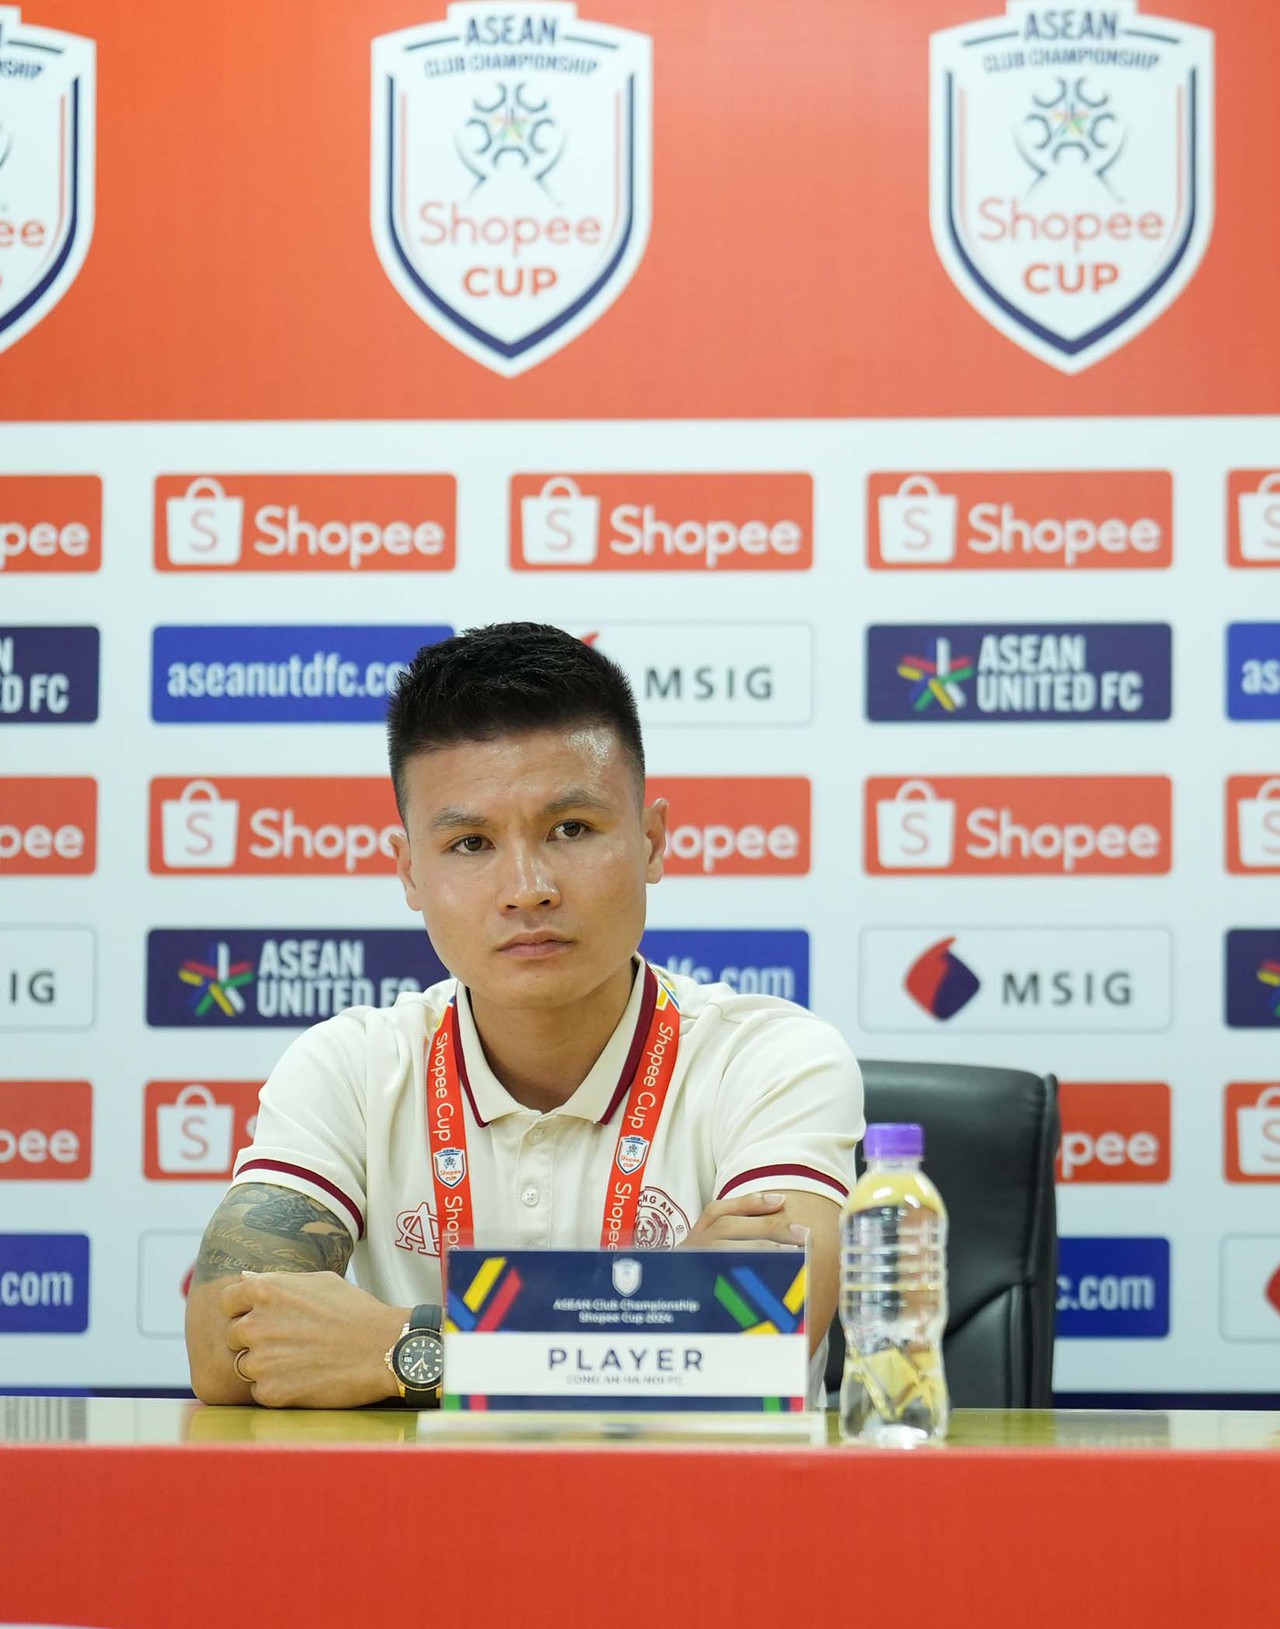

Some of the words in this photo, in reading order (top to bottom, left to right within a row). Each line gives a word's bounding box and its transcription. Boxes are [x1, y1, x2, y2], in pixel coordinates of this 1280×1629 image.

[465, 16, 559, 46] ASEAN
[1023, 10, 1119, 42] ASEAN
[424, 56, 467, 77] CLUB
[472, 52, 600, 77] CHAMPIONSHIP
[983, 51, 1025, 74] CLUB
[1029, 48, 1160, 73] CHAMPIONSHIP
[418, 200, 602, 256] Shopee
[978, 196, 1164, 253] Shopee
[463, 266, 559, 298] CUP
[1023, 263, 1119, 294] CUP
[254, 505, 444, 569] Shopee
[610, 505, 801, 568] Shopee
[967, 503, 1161, 566] Shopee
[977, 635, 1086, 672] ASEAN
[30, 674, 69, 714] FC
[645, 666, 774, 700] MSIG
[976, 673, 1096, 713] UNITED
[1102, 672, 1143, 712] FC
[966, 809, 1160, 871] Shopee
[258, 940, 364, 977] ASEAN
[257, 979, 372, 1017] UNITED
[1002, 971, 1133, 1006] MSIG
[430, 1032, 448, 1099] Shopee
[643, 1021, 674, 1087] Shopee
[433, 1103, 454, 1141] Cup
[628, 1092, 656, 1129] Cup
[659, 1201, 674, 1216] AN
[553, 1298, 591, 1310] ASEAN
[593, 1298, 618, 1310] Club
[619, 1298, 700, 1312] Championship
[578, 1312, 620, 1324] Shopee
[621, 1312, 643, 1325] Cup
[549, 1349, 703, 1371] PLAYER
